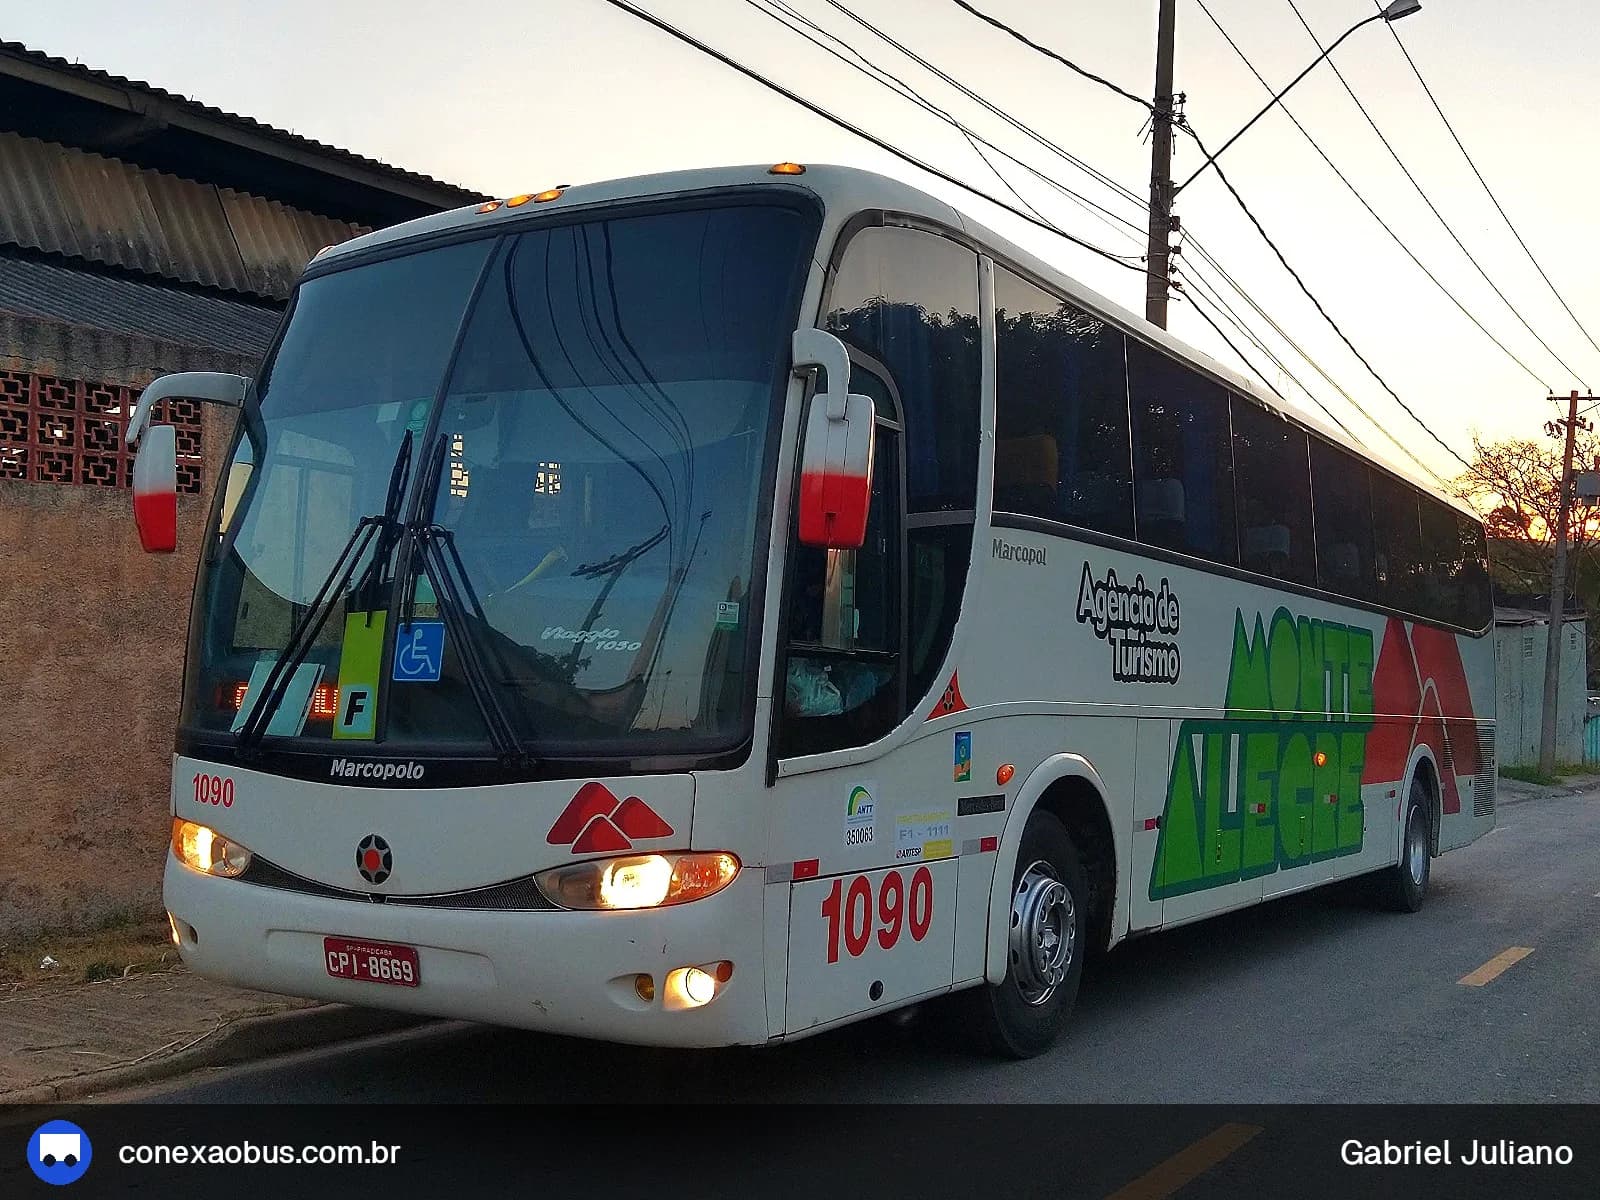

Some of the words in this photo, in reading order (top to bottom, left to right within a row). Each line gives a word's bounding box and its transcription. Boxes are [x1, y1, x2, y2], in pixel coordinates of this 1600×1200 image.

[992, 538, 1047, 566] Marcopol
[1077, 564, 1155, 635] Agência
[1156, 582, 1180, 631] de
[1111, 627, 1180, 681] Turismo
[1224, 606, 1374, 723] MONTE
[343, 691, 368, 727] F
[330, 758, 425, 781] Marcopolo
[192, 772, 235, 809] 1090
[856, 804, 874, 815] ANTT
[1149, 719, 1368, 901] ALEGRE
[846, 826, 873, 846] 350063
[820, 865, 934, 965] 1090
[328, 951, 413, 982] CPI-8669
